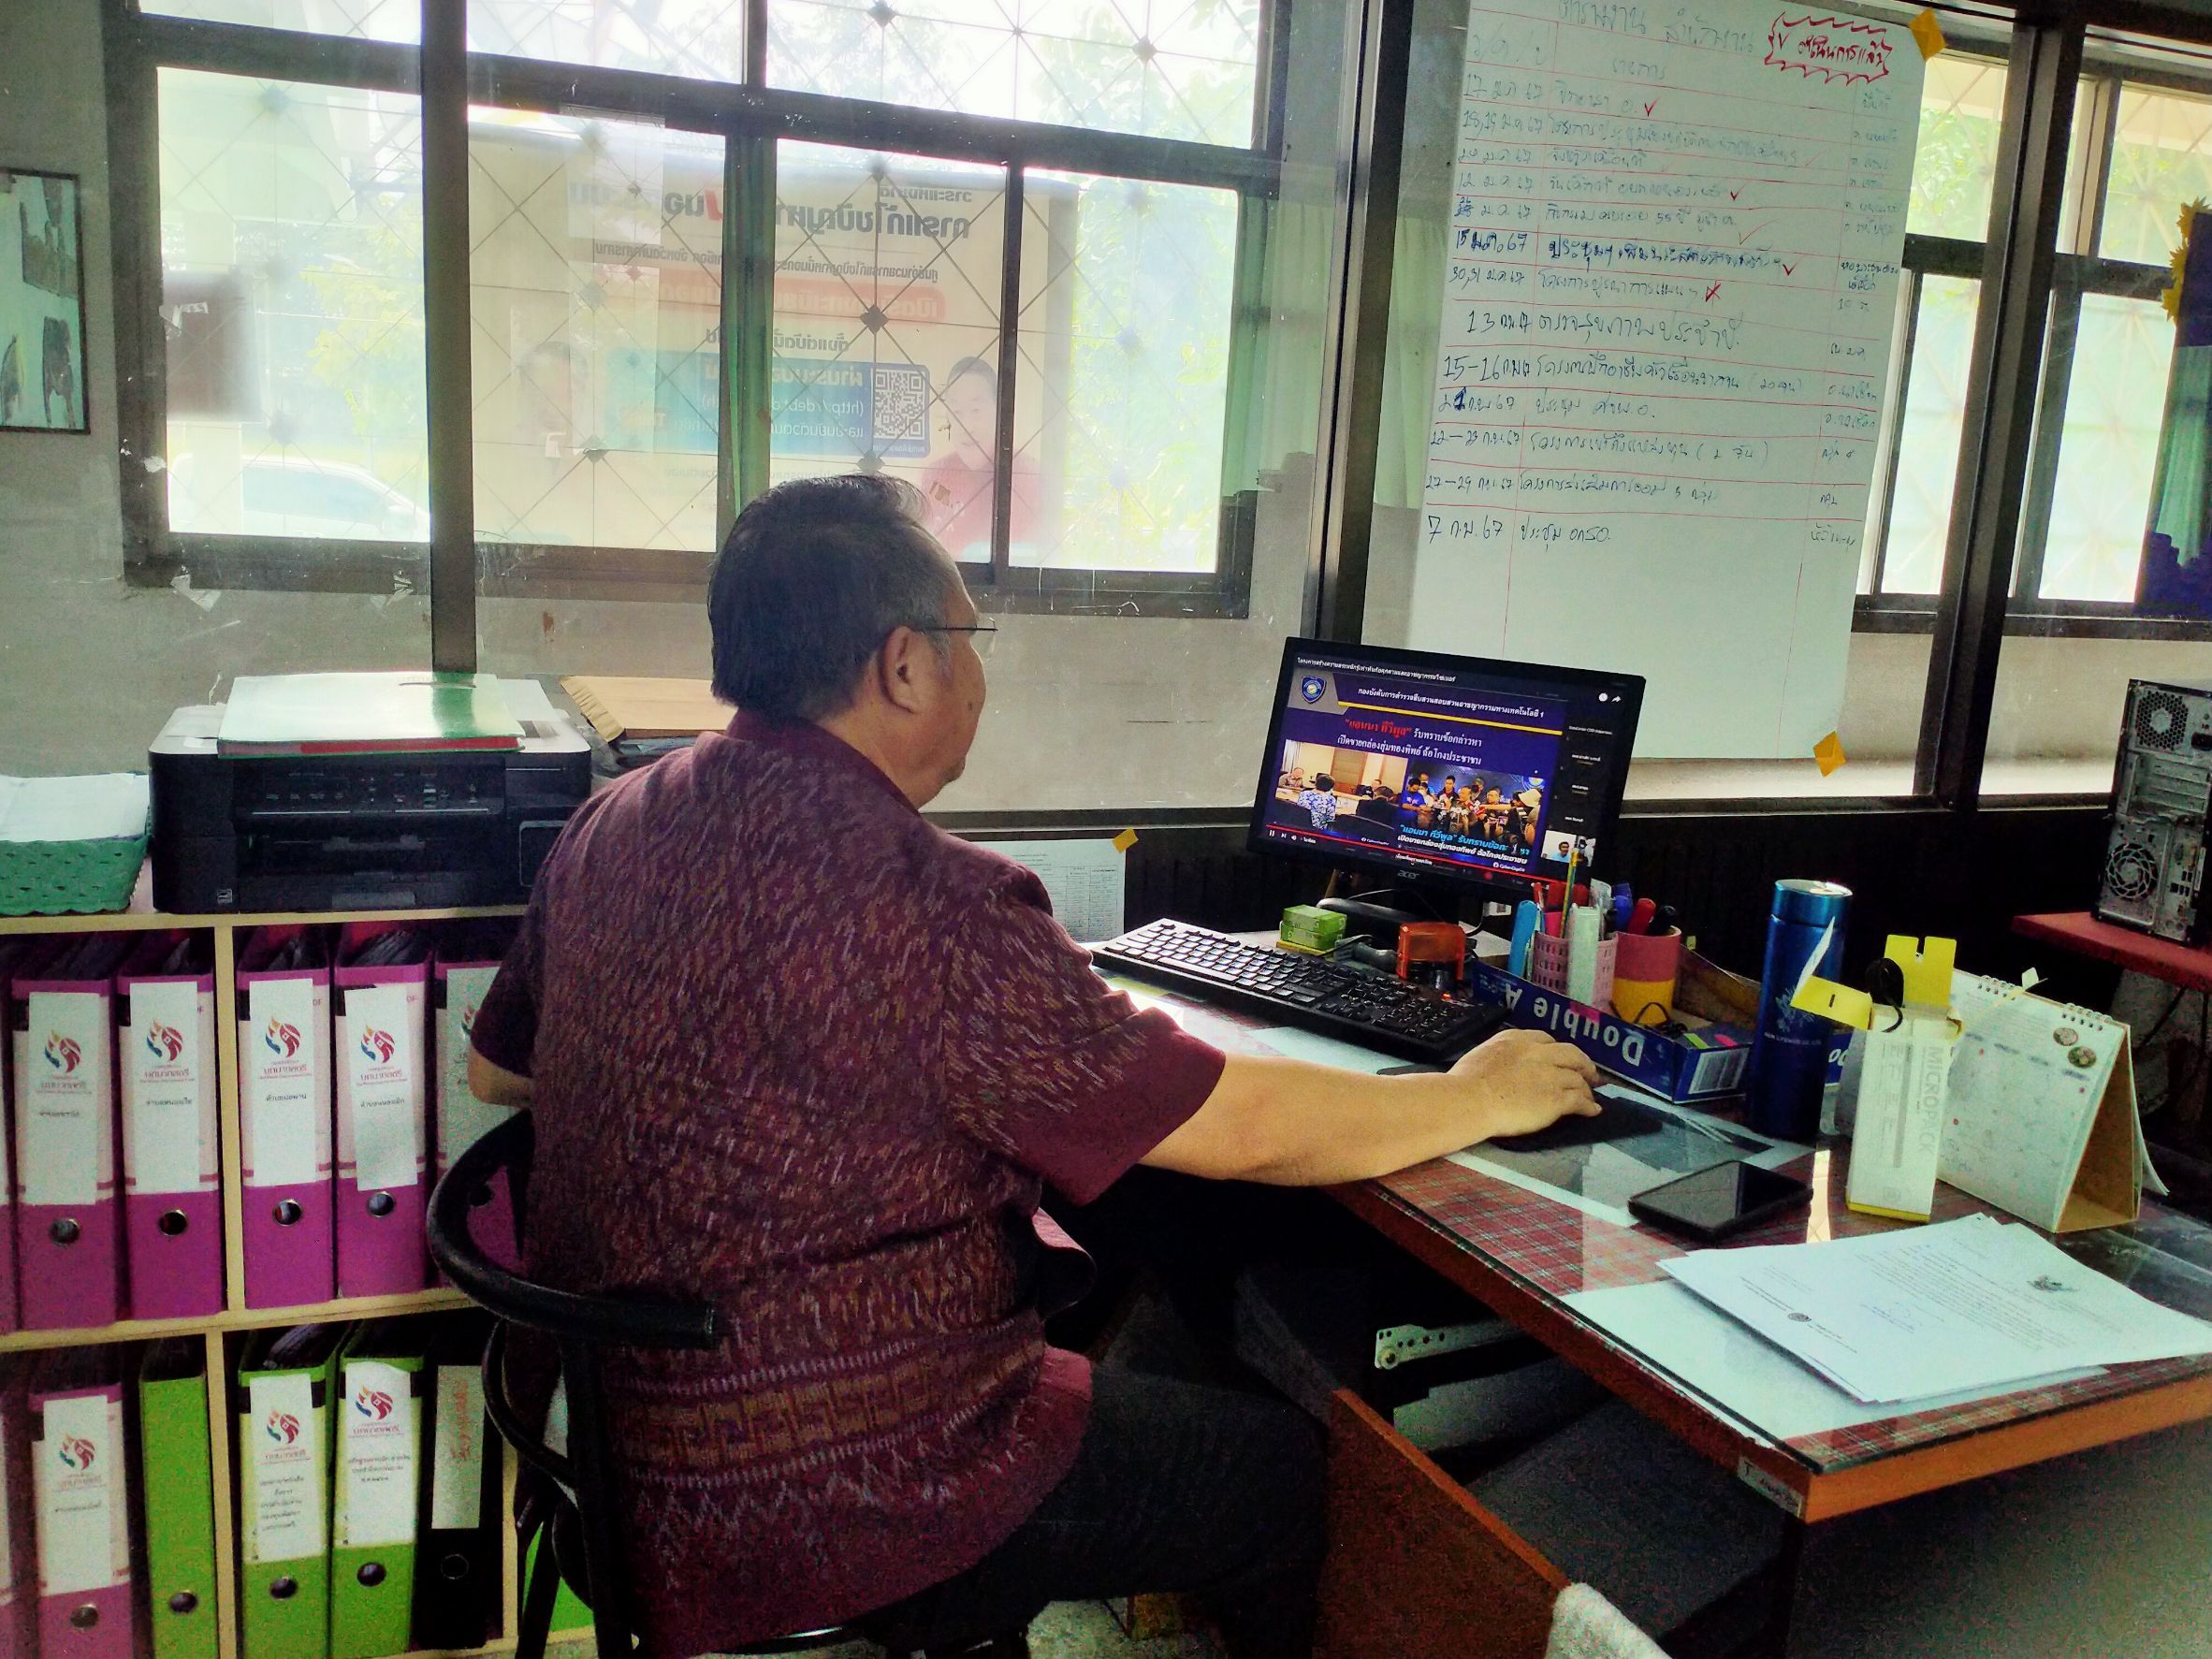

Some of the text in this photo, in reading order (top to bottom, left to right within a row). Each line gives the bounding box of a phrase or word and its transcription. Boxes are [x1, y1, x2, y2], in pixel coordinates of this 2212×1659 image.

[1468, 310, 1495, 334] 13
[1427, 515, 1443, 545] 7
[1481, 514, 1504, 540] 67
[1413, 727, 1483, 748] รับทราบข้อกล่าวหา
[1422, 748, 1482, 765] ฉ้อโกงประชาชน
[1396, 868, 1421, 880] acer
[1504, 982, 1523, 1011] A
[1532, 996, 1646, 1068] Double
[1918, 1045, 1944, 1158] MICROPACK
